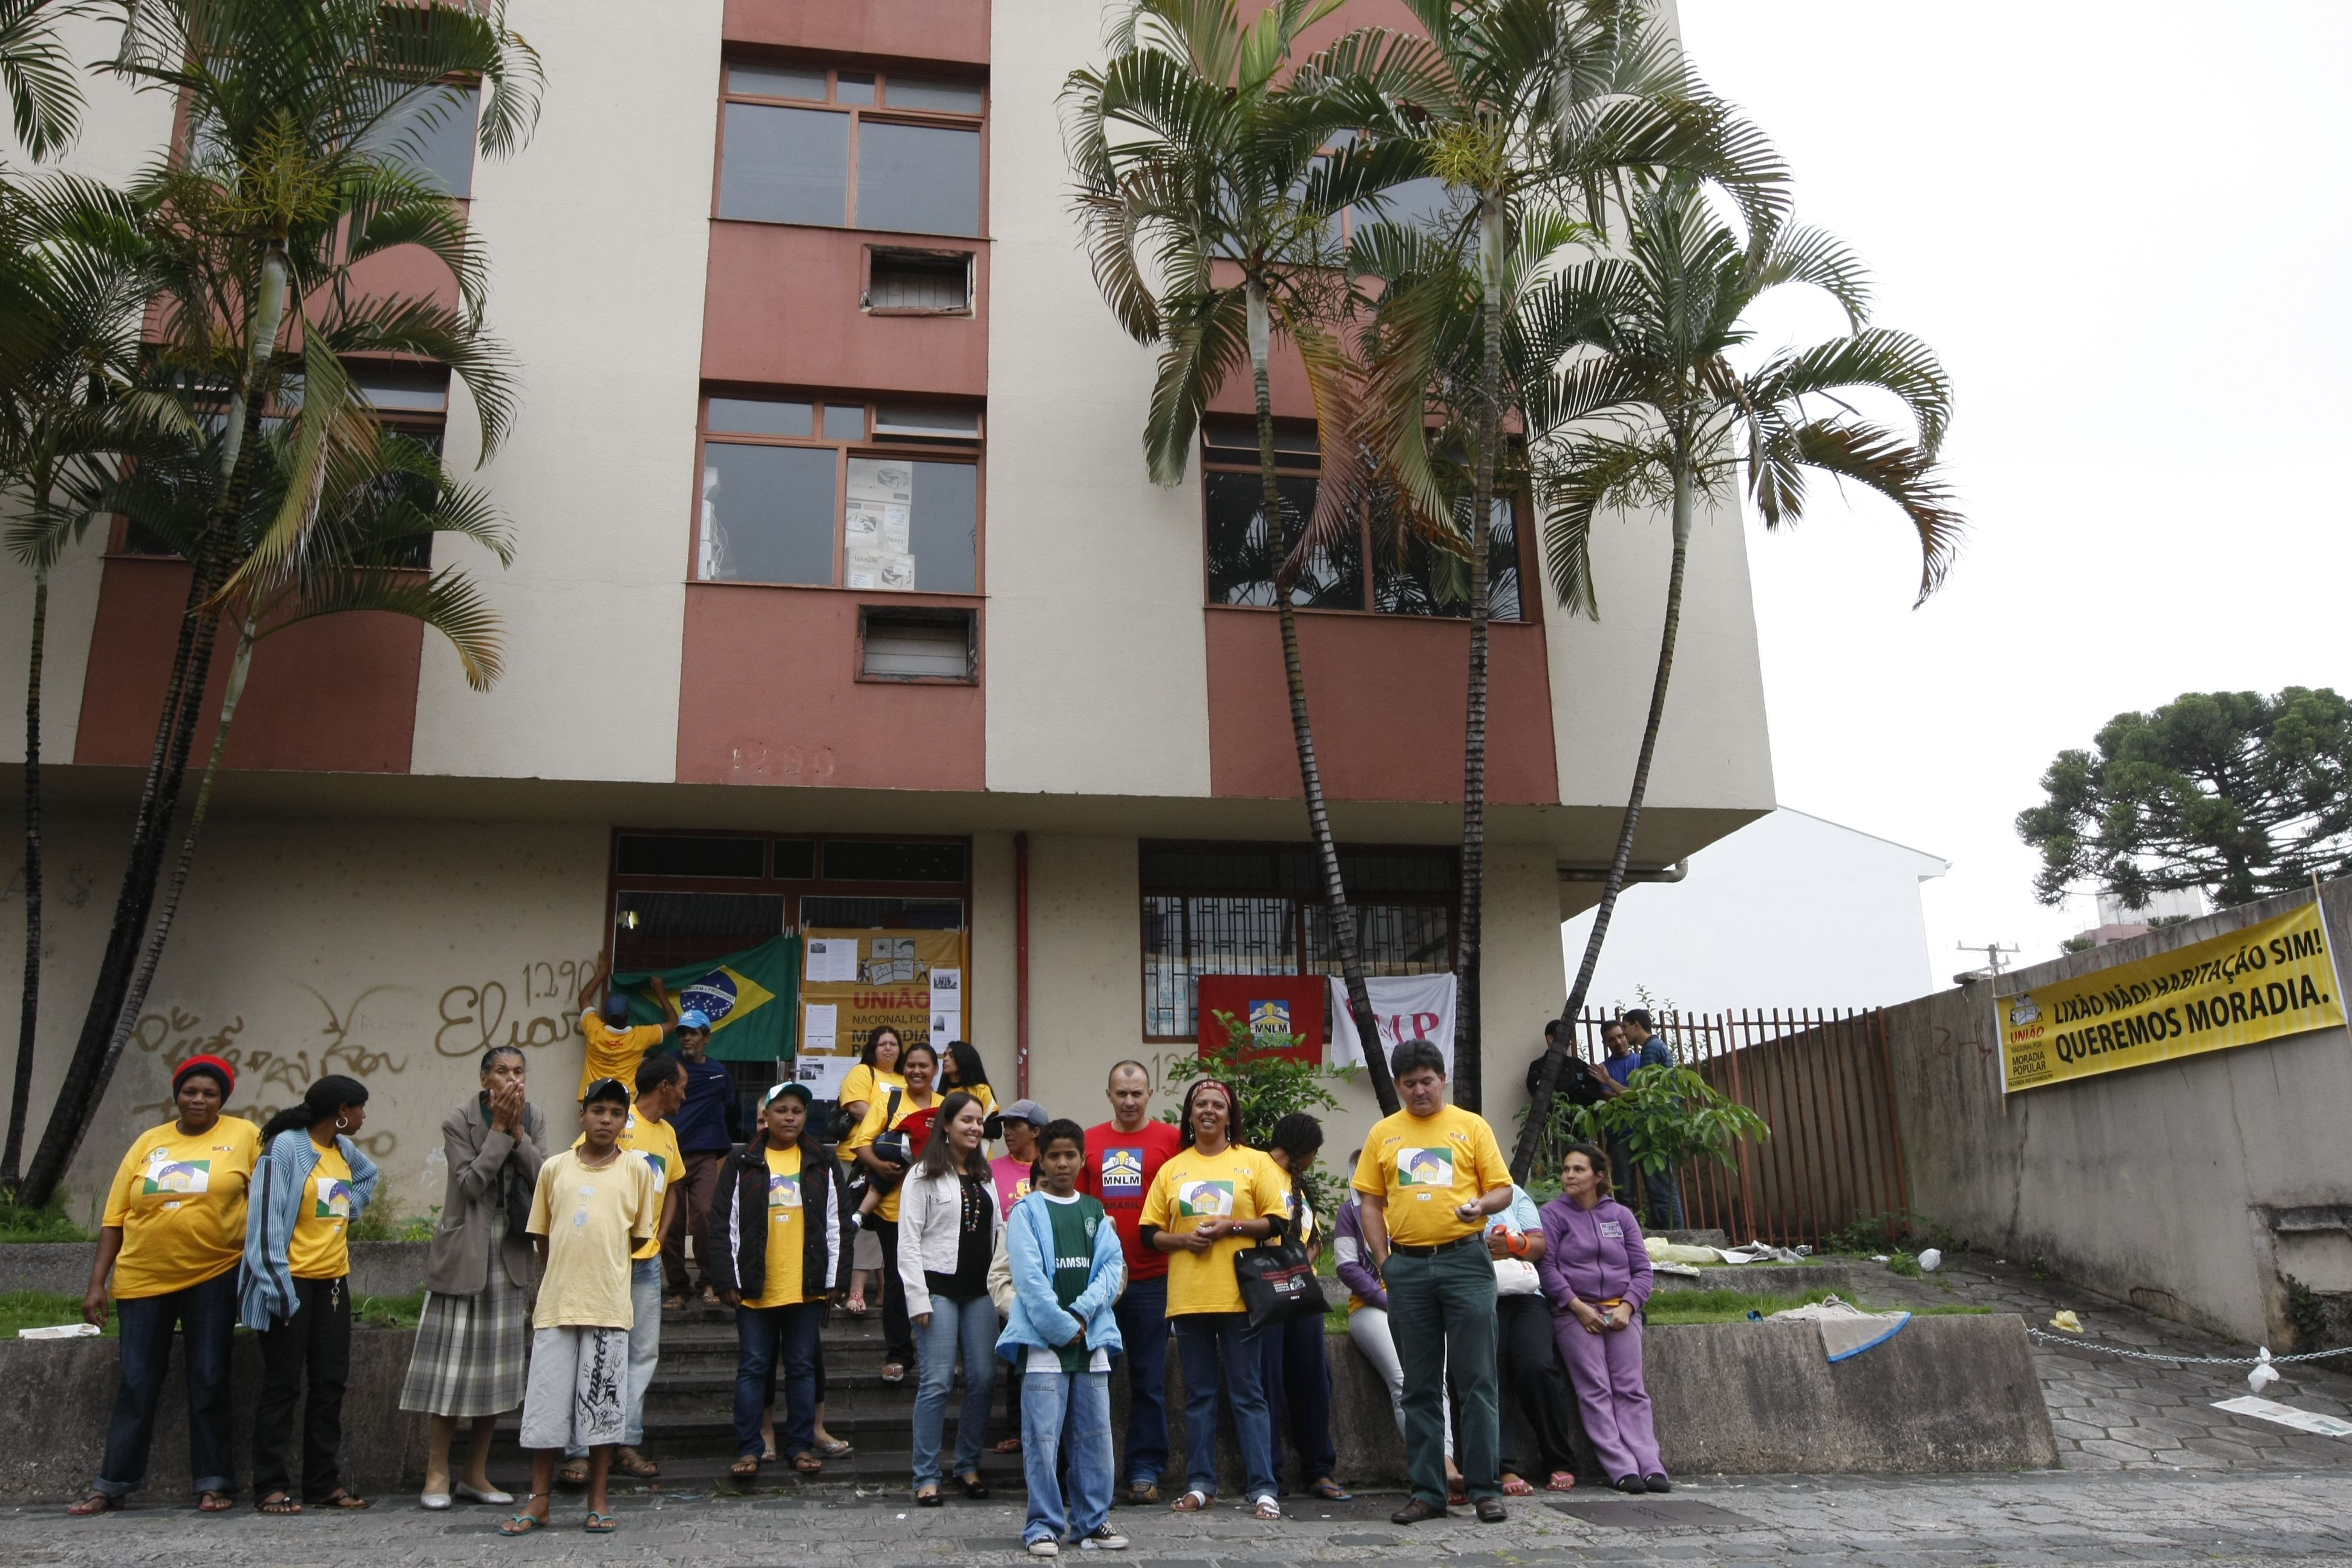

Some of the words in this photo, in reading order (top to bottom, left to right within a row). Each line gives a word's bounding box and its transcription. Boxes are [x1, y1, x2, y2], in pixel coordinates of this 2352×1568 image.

[2054, 993, 2104, 1024] LIXÃO
[2102, 983, 2151, 1013] NÃO!
[2151, 944, 2266, 998] HABITAÇÃO
[2269, 928, 2323, 965] SIM!
[854, 987, 930, 1010] UNIÃO
[852, 1014, 907, 1024] NACIONAL
[910, 1014, 930, 1024] POR
[2056, 1007, 2181, 1063] QUEREMOS
[2184, 974, 2329, 1034] MORADIA.
[852, 1029, 930, 1042] MDIA
[1255, 1024, 1287, 1033] MNLM
[2010, 1024, 2045, 1044] UNIÃO
[2012, 1051, 2045, 1066] MORADIA
[2013, 1060, 2046, 1076] POPULAR
[1385, 1135, 1402, 1145] CAIXA
[1103, 1175, 1140, 1185] MNLM
[1103, 1201, 1142, 1210] BRASIL
